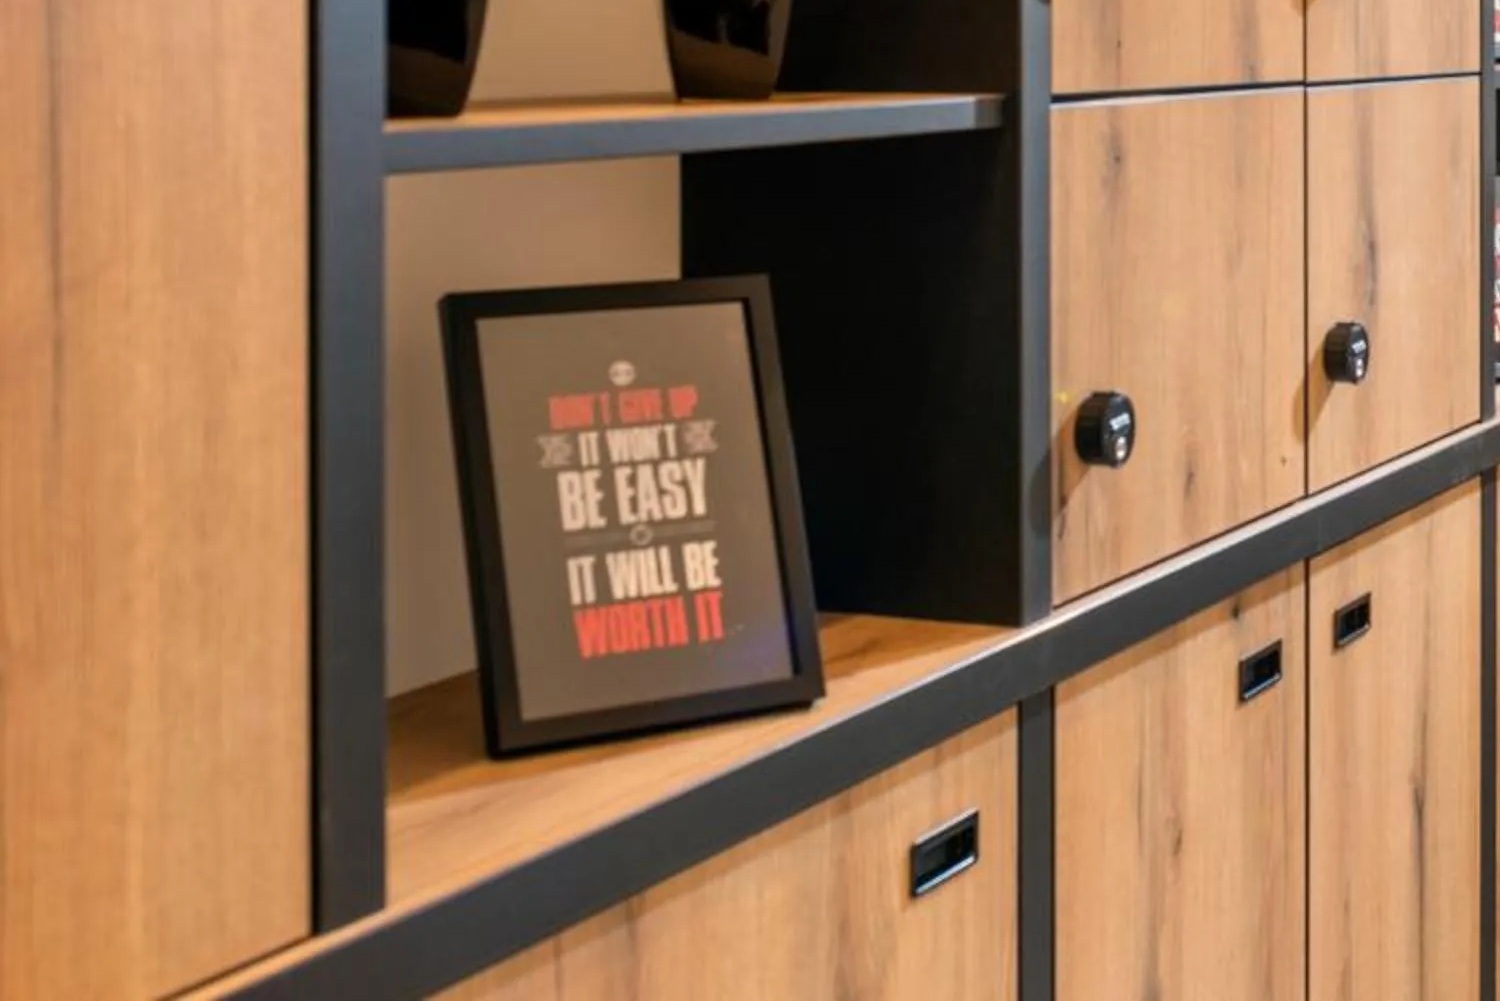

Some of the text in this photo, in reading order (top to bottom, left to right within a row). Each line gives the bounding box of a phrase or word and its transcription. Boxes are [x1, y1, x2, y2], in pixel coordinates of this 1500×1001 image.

[578, 422, 678, 467] IT WON'T
[557, 457, 706, 531] BE EASY
[567, 540, 723, 606] IT WILL BE
[574, 590, 725, 660] WORTH IT
